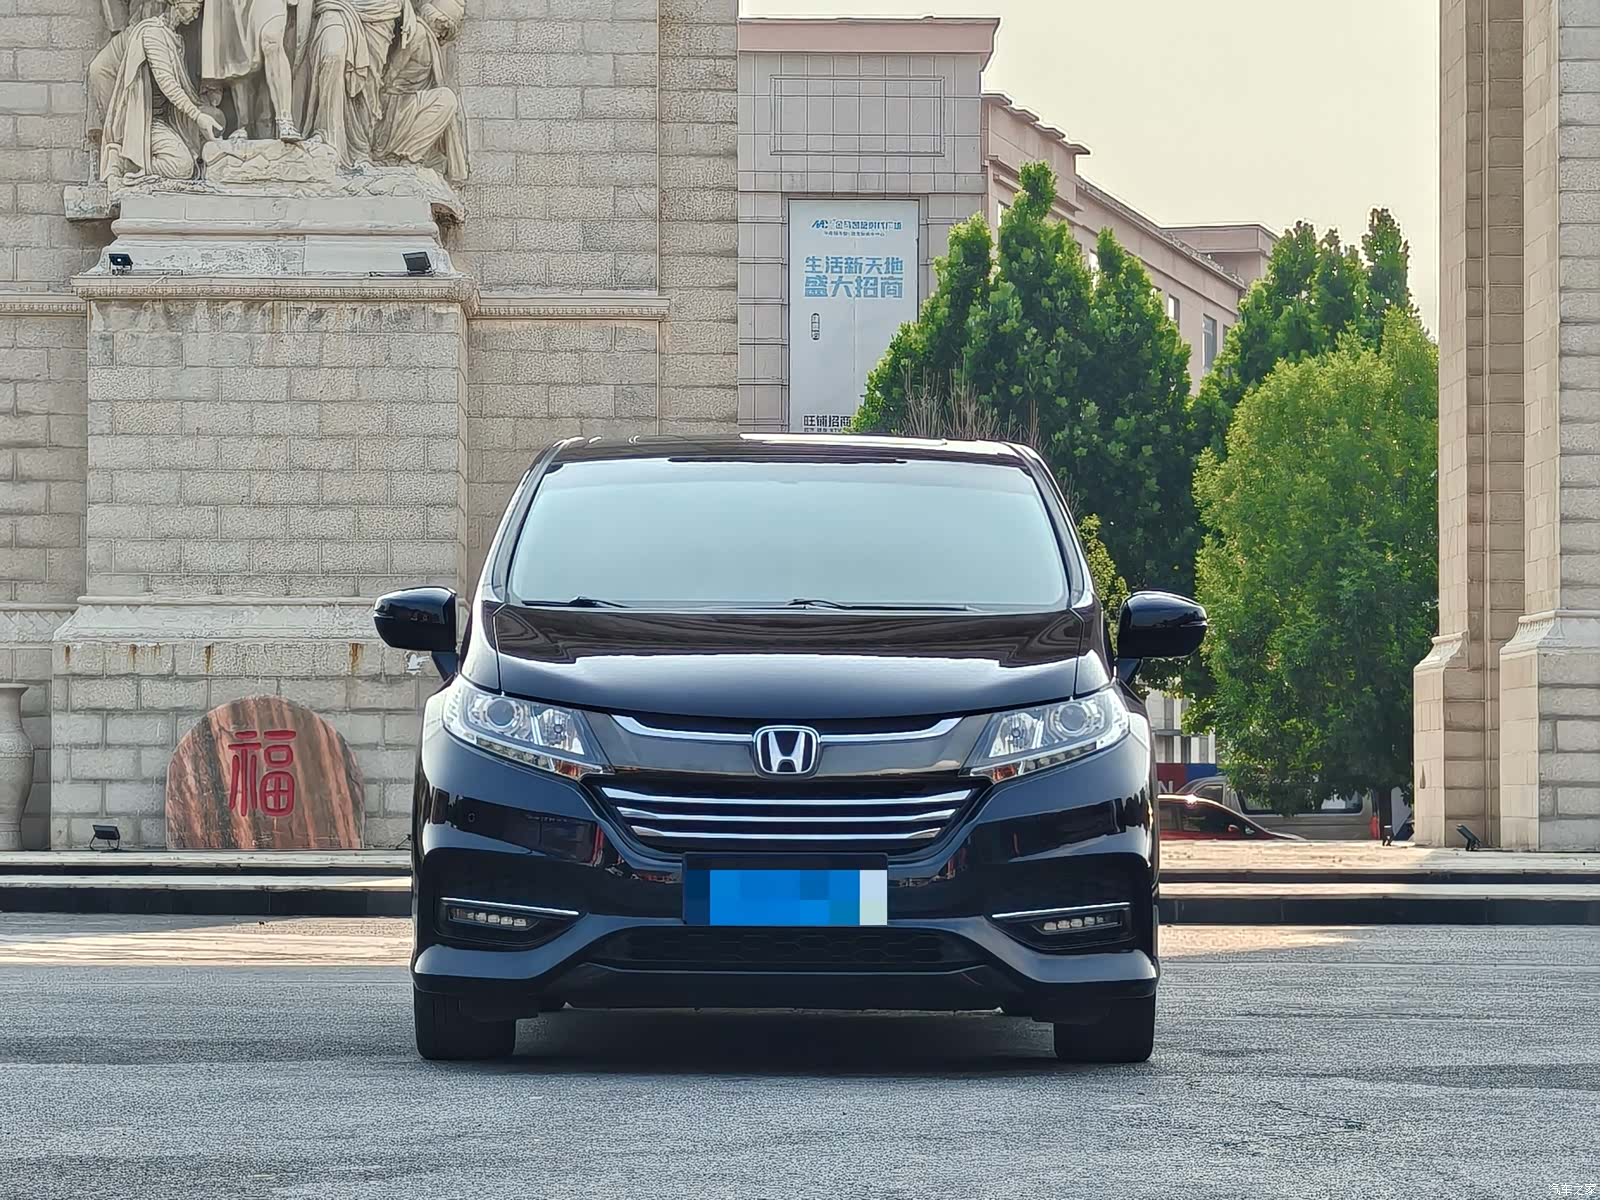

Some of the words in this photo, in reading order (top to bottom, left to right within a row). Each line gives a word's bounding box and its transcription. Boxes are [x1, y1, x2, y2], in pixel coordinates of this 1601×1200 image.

[805, 256, 903, 274] 生活新天地
[805, 275, 903, 298] 盛大招商
[803, 415, 852, 427] 旺铺招商
[228, 730, 296, 817] 福
